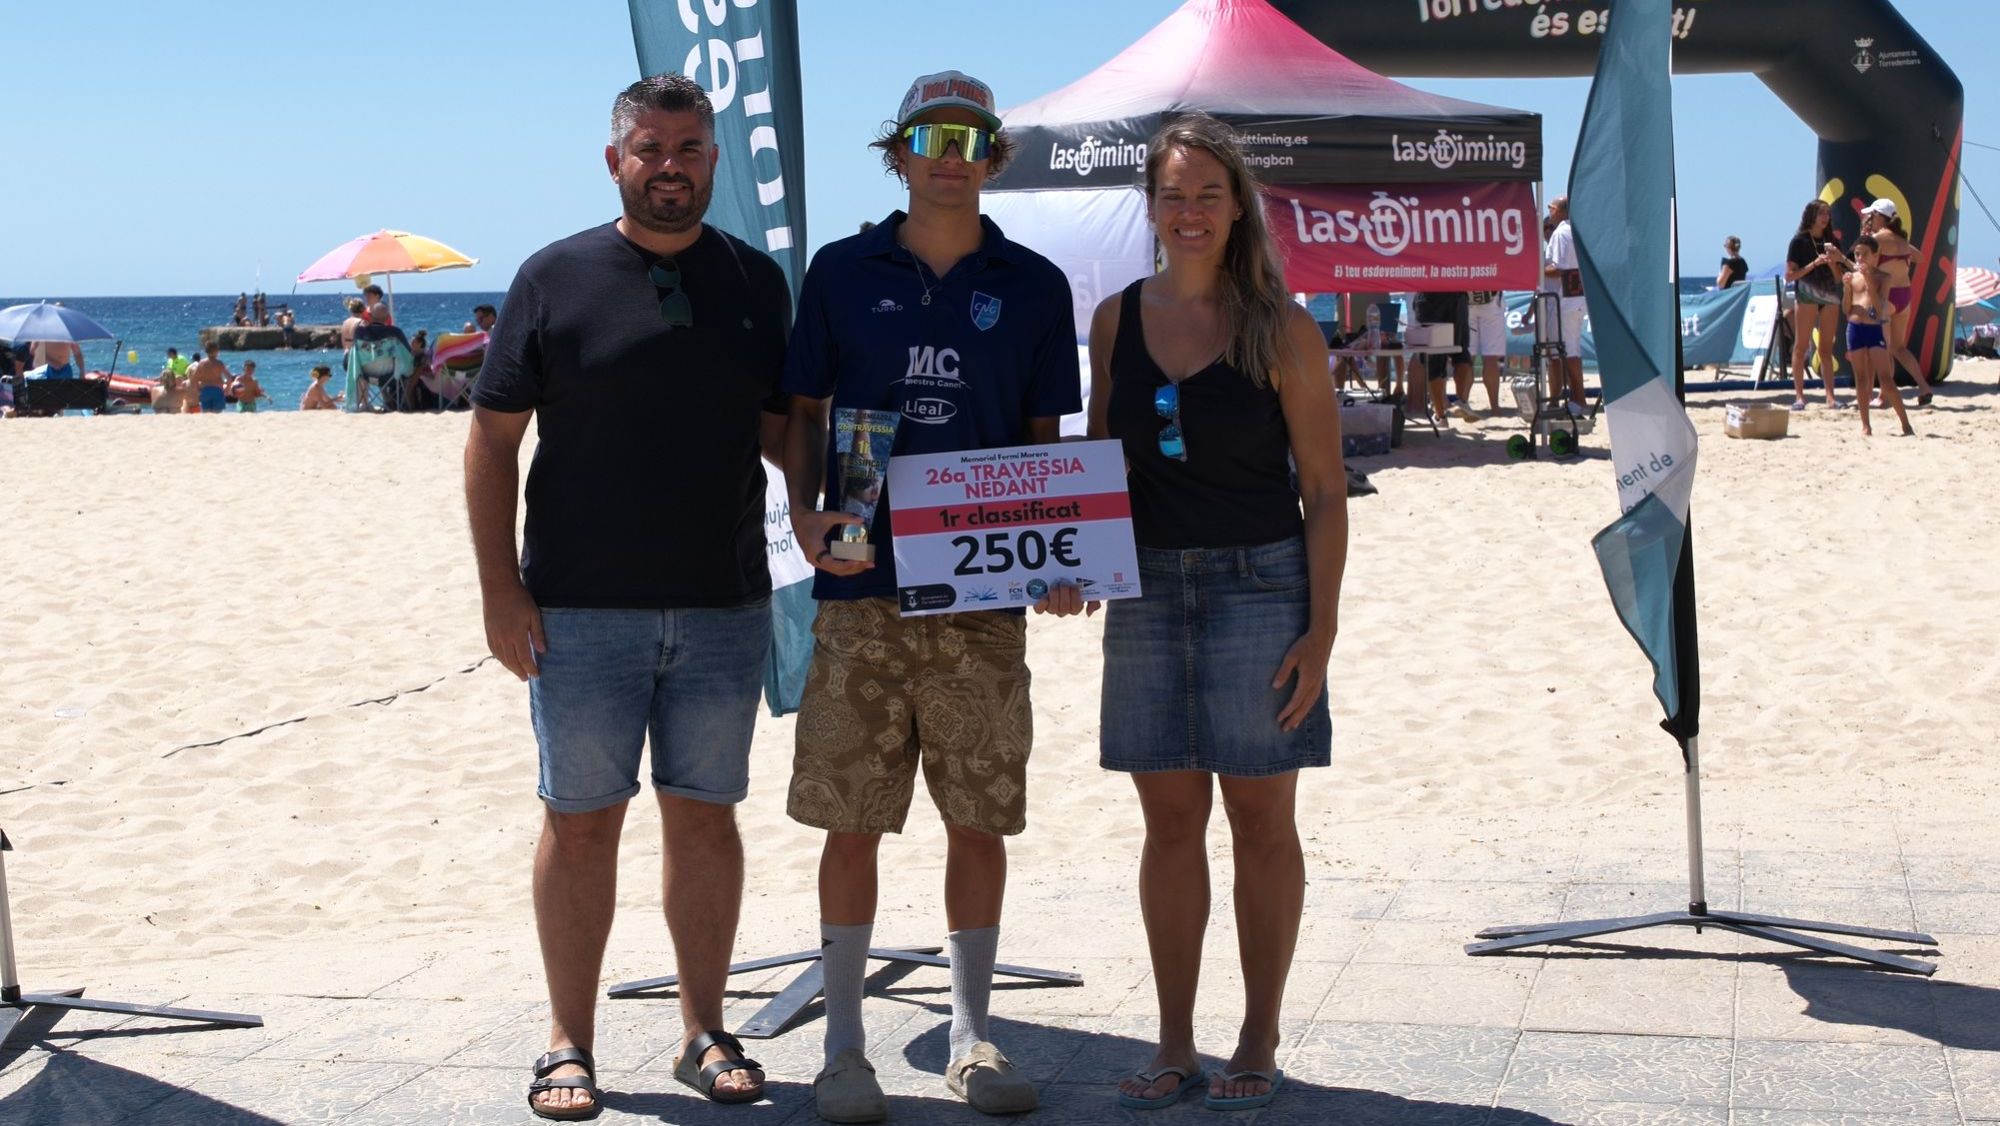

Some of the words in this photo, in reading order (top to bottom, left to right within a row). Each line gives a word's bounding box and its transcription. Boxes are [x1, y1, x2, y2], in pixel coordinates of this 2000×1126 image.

[1530, 4, 1569, 38] és
[1345, 265, 1360, 277] teu
[1362, 265, 1428, 278] esdeveniment,
[1430, 265, 1439, 277] la
[1441, 265, 1468, 277] nostra
[1470, 264, 1497, 278] passió
[905, 345, 960, 379] MC
[905, 400, 943, 416] Lleal
[960, 454, 997, 464] Memorial
[1020, 451, 1049, 459] Morera
[1650, 452, 1674, 473] de
[925, 467, 966, 485] 26a
[970, 457, 1085, 481] TRAVESSIA
[964, 477, 1049, 499] NEDANT
[939, 509, 961, 528] 1r
[967, 500, 1081, 526] classificat
[951, 527, 1081, 576] 250€
